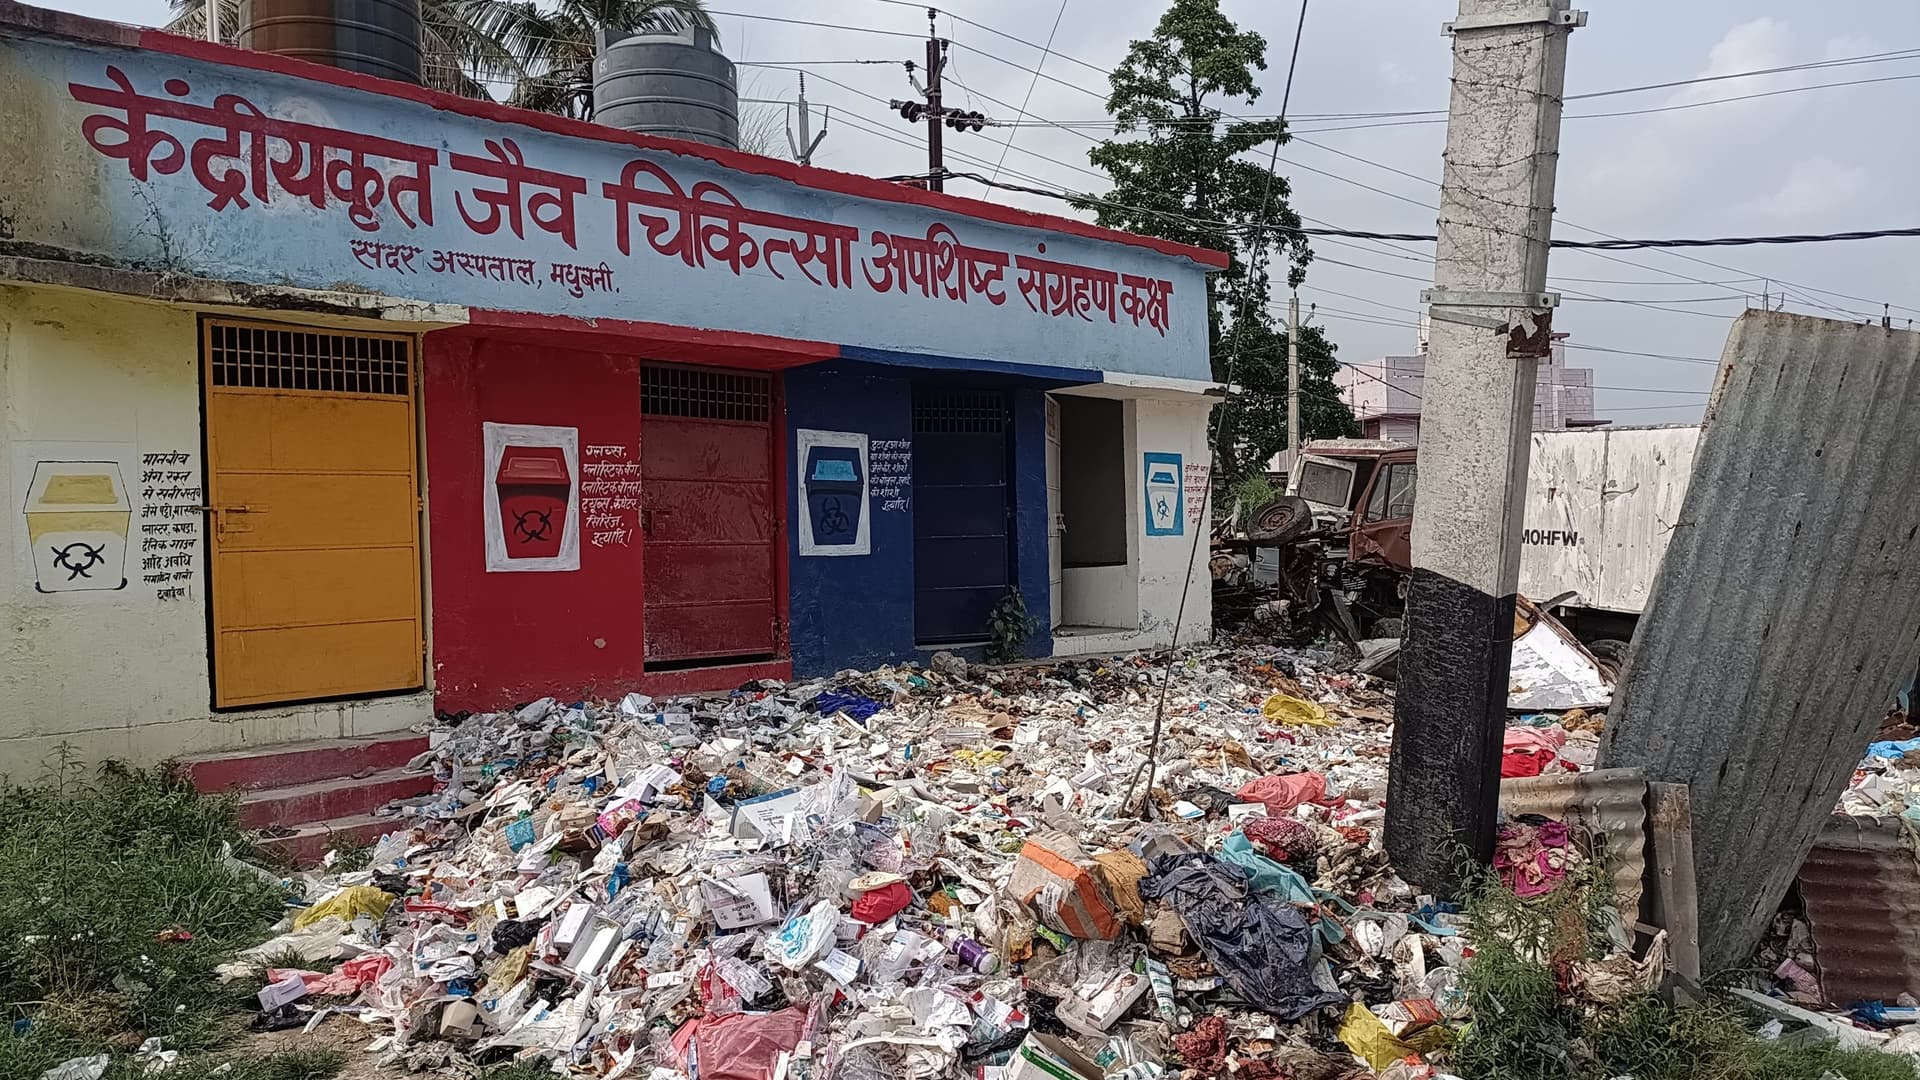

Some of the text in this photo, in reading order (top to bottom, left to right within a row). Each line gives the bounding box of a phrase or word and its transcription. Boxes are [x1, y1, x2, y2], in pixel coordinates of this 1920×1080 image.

[70, 65, 1173, 337] केंद्रीयकृत जैव चिकित्सा अपशिष्ट संग्रहण कक्ष
[350, 240, 423, 274] सदर
[427, 250, 542, 289] अस्पताल,
[143, 450, 190, 466] मानवीय
[583, 460, 625, 478] प्लास्टिक
[142, 485, 156, 500] से
[581, 477, 618, 496] प्लास्टिक
[142, 552, 193, 570] आदि अवधि
